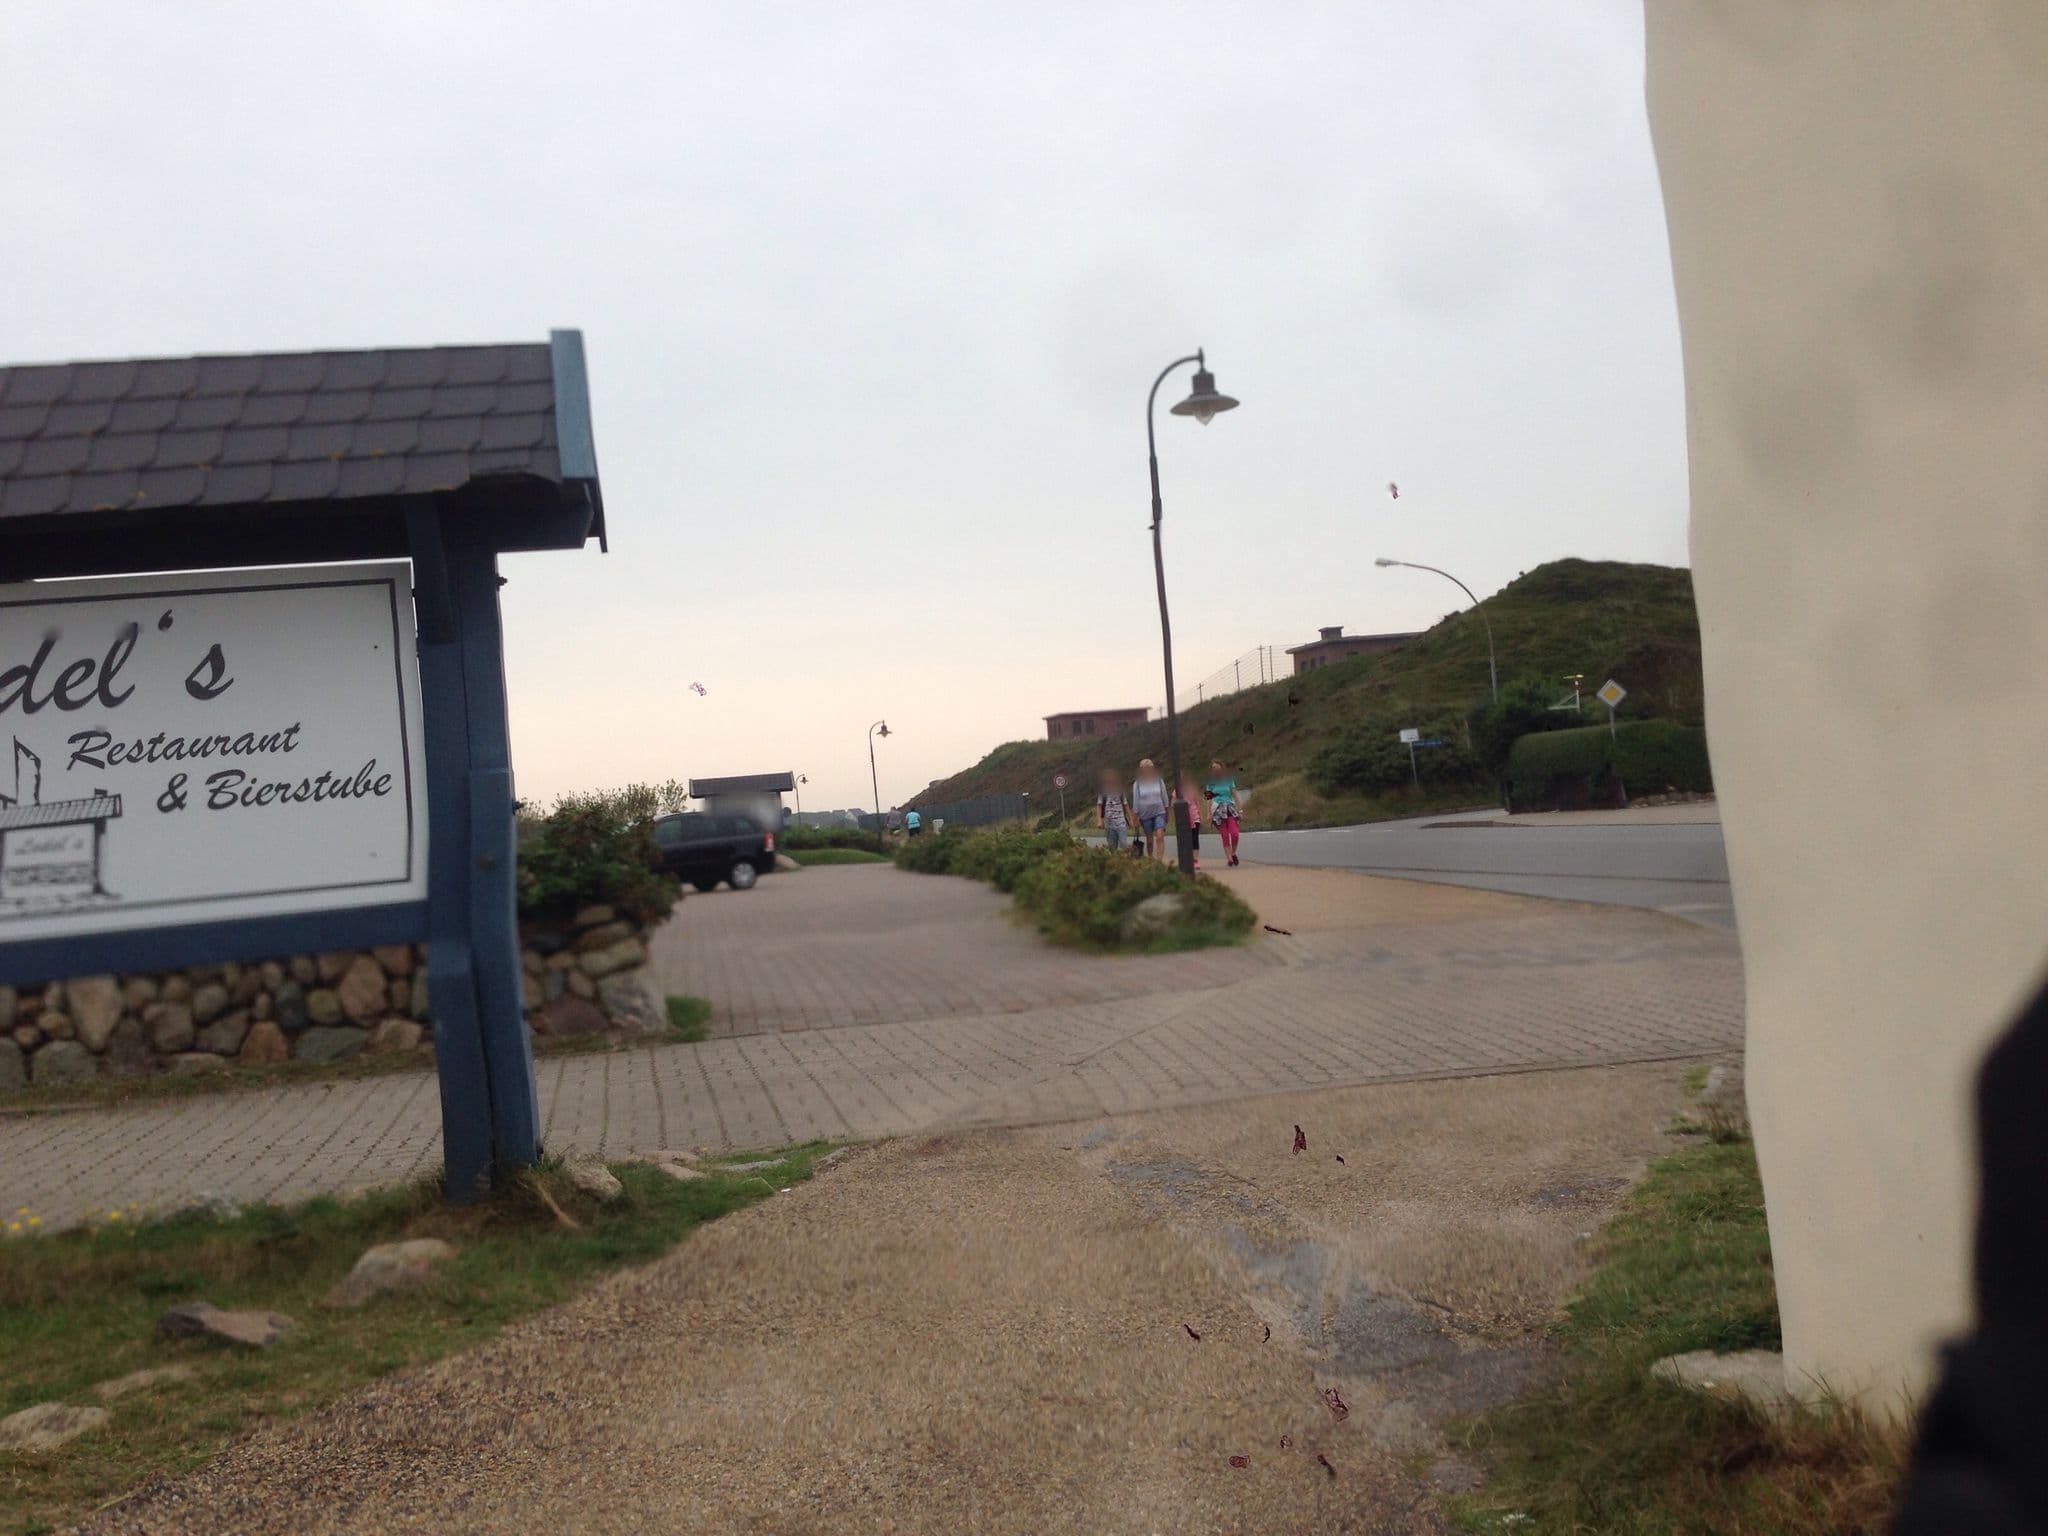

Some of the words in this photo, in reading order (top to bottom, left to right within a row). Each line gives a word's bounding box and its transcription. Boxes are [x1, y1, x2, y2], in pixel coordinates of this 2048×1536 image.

[67, 721, 301, 771] Restaurant
[156, 772, 188, 814] &
[204, 758, 393, 811] Bierstube
